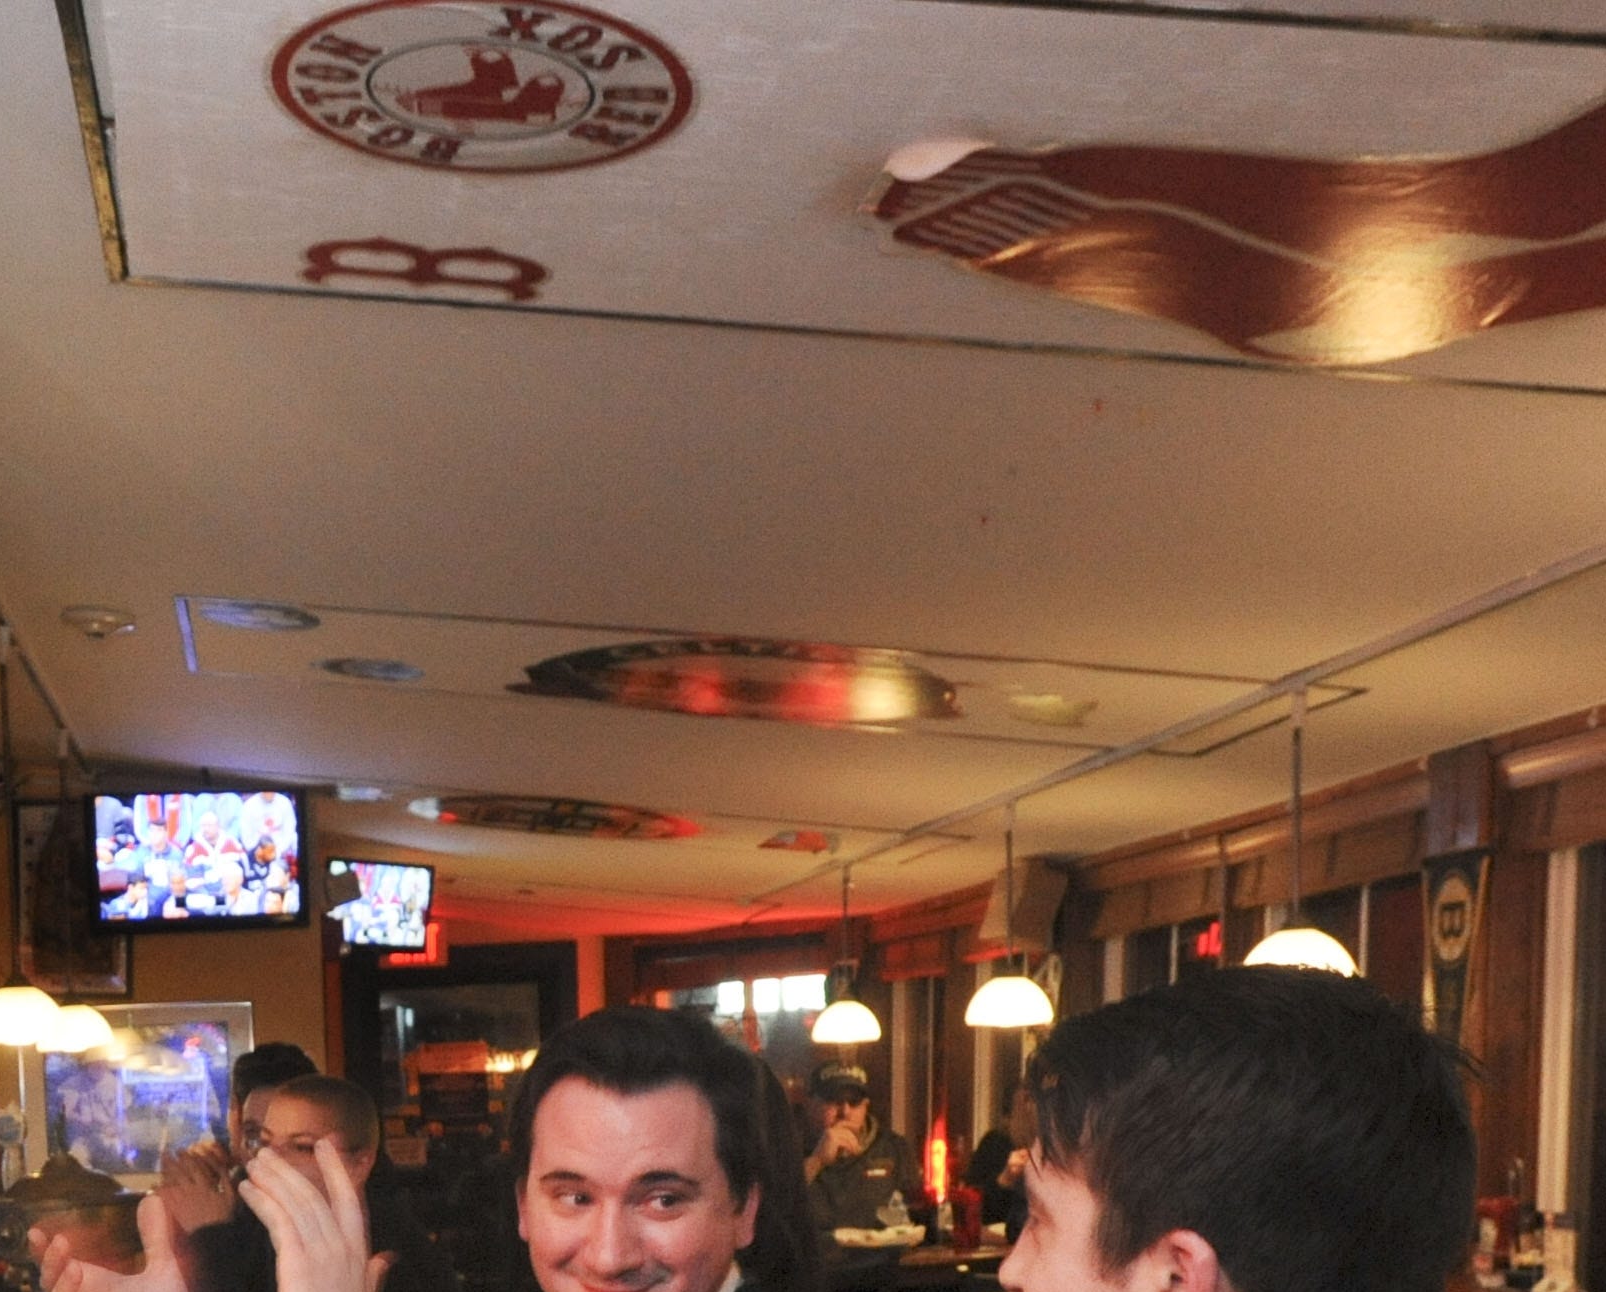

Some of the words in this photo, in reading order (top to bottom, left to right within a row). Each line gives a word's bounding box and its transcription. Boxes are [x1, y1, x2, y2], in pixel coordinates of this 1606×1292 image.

[489, 8, 646, 71] SOX
[296, 33, 463, 163] BOSTON
[568, 86, 669, 147] RED
[303, 237, 551, 300] B
